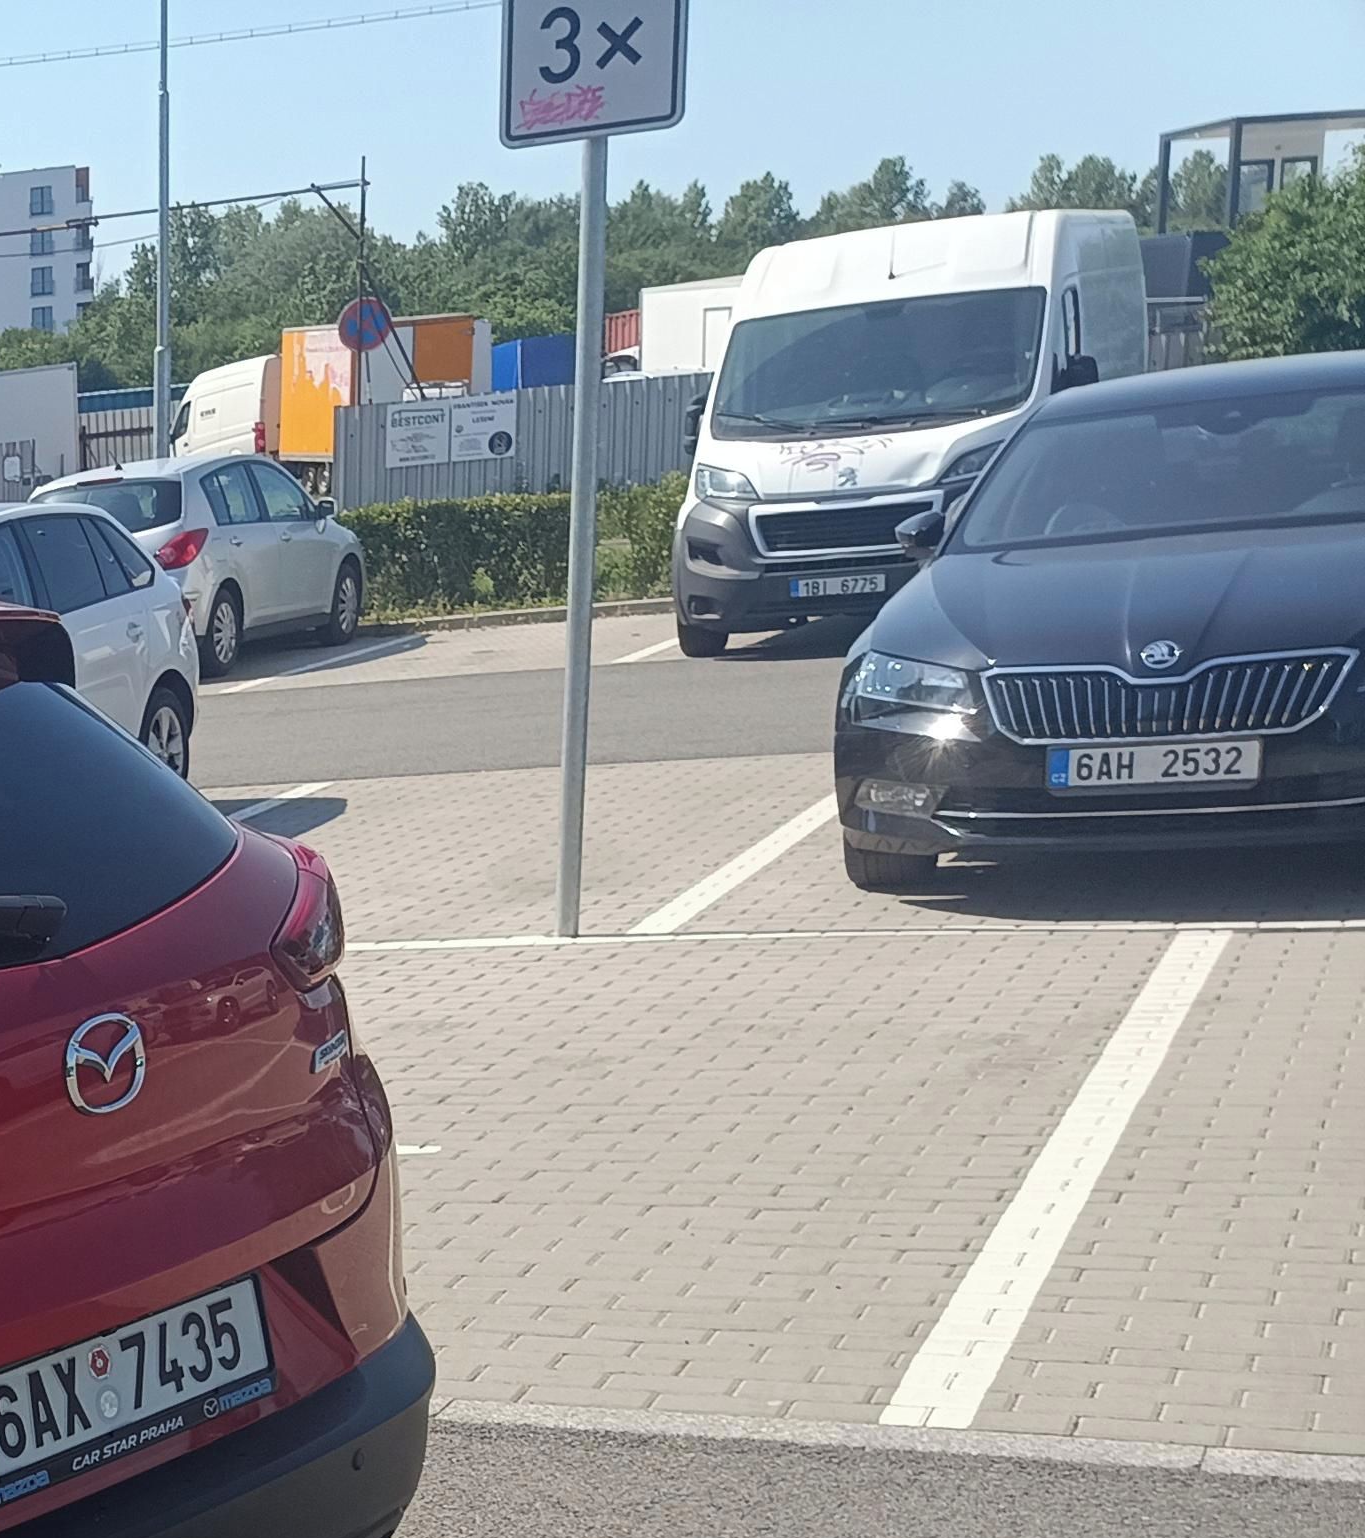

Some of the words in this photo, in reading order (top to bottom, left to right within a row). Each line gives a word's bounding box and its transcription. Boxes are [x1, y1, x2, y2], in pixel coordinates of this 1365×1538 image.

[1051, 773, 1066, 783] CZ
[1076, 750, 1135, 781] 6AH
[1161, 746, 1243, 778] 2532
[119, 1297, 241, 1410] 7435
[72, 1450, 101, 1471] CAR
[102, 1434, 137, 1459] STAR
[139, 1415, 184, 1444] PRAHA
